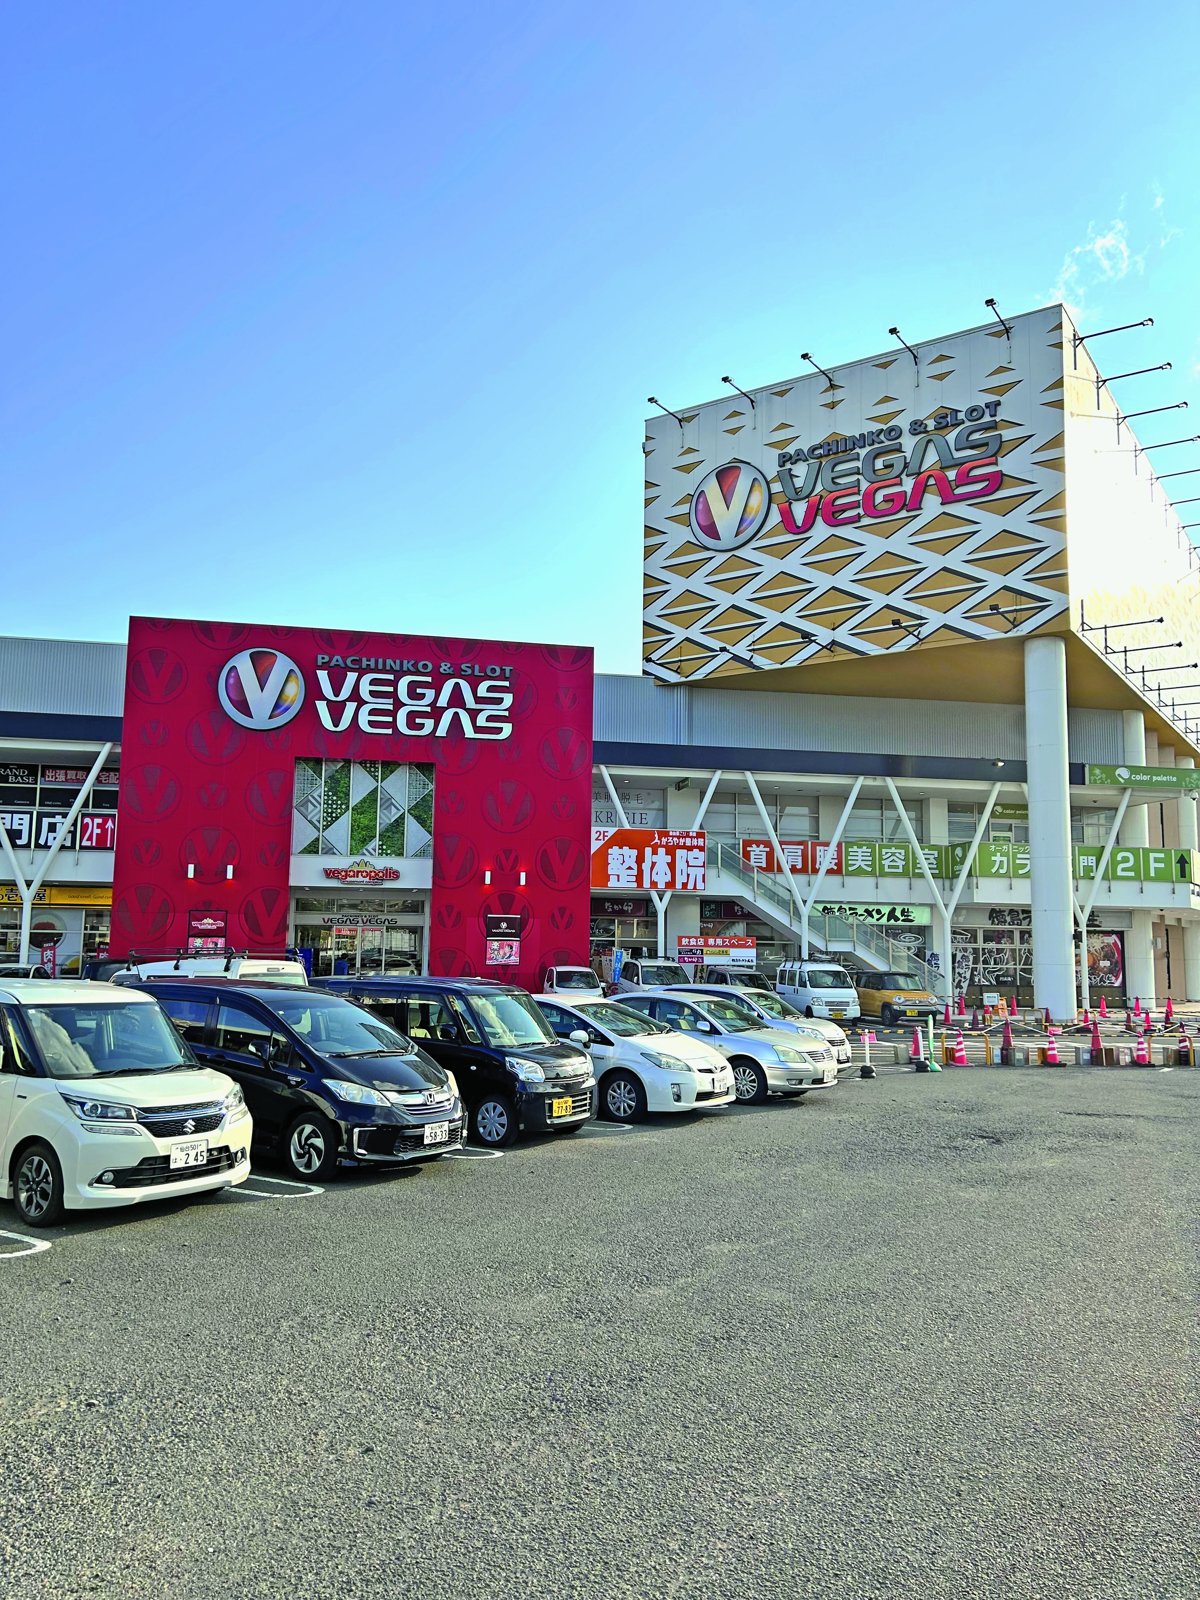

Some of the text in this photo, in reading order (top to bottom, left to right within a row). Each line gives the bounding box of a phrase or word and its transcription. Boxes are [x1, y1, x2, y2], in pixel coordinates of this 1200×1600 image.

[778, 400, 1001, 467] PACHINKO & SLOT
[777, 420, 1002, 501] VEGAS
[778, 456, 1003, 534] VEGAS
[316, 655, 513, 678] PACHINKO & SLOT
[316, 670, 513, 710] VEGAS
[315, 700, 513, 740] VEGAS
[45, 769, 87, 782] 出張買取
[1131, 773, 1177, 782] color palette
[81, 818, 102, 847] 2F
[595, 830, 609, 842] 2F
[323, 866, 400, 880] vegaropolis
[608, 846, 705, 890] 整体院
[322, 917, 398, 925] VEGAS VEGAS
[681, 938, 753, 946] 飲食店 専用スペース
[430, 1130, 447, 1141] 58-33
